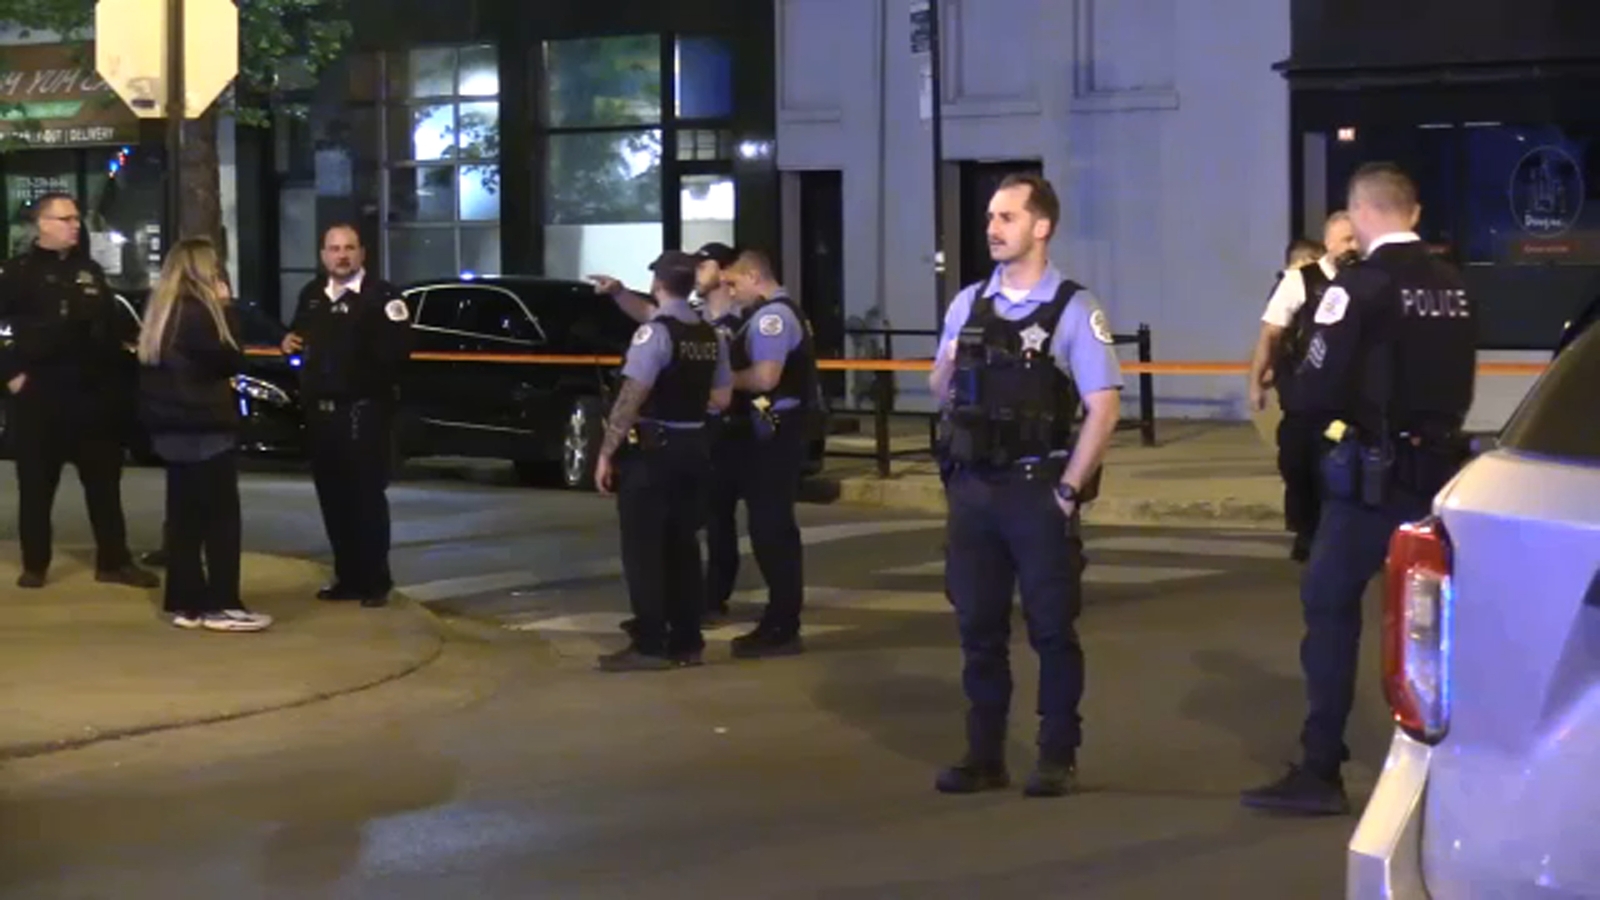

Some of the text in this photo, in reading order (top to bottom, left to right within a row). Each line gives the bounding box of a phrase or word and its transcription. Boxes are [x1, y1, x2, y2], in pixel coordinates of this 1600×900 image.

[26, 70, 80, 94] YUM
[69, 127, 115, 141] DELIVERY
[1401, 289, 1469, 317] POLICE
[680, 340, 717, 361] POLICE
